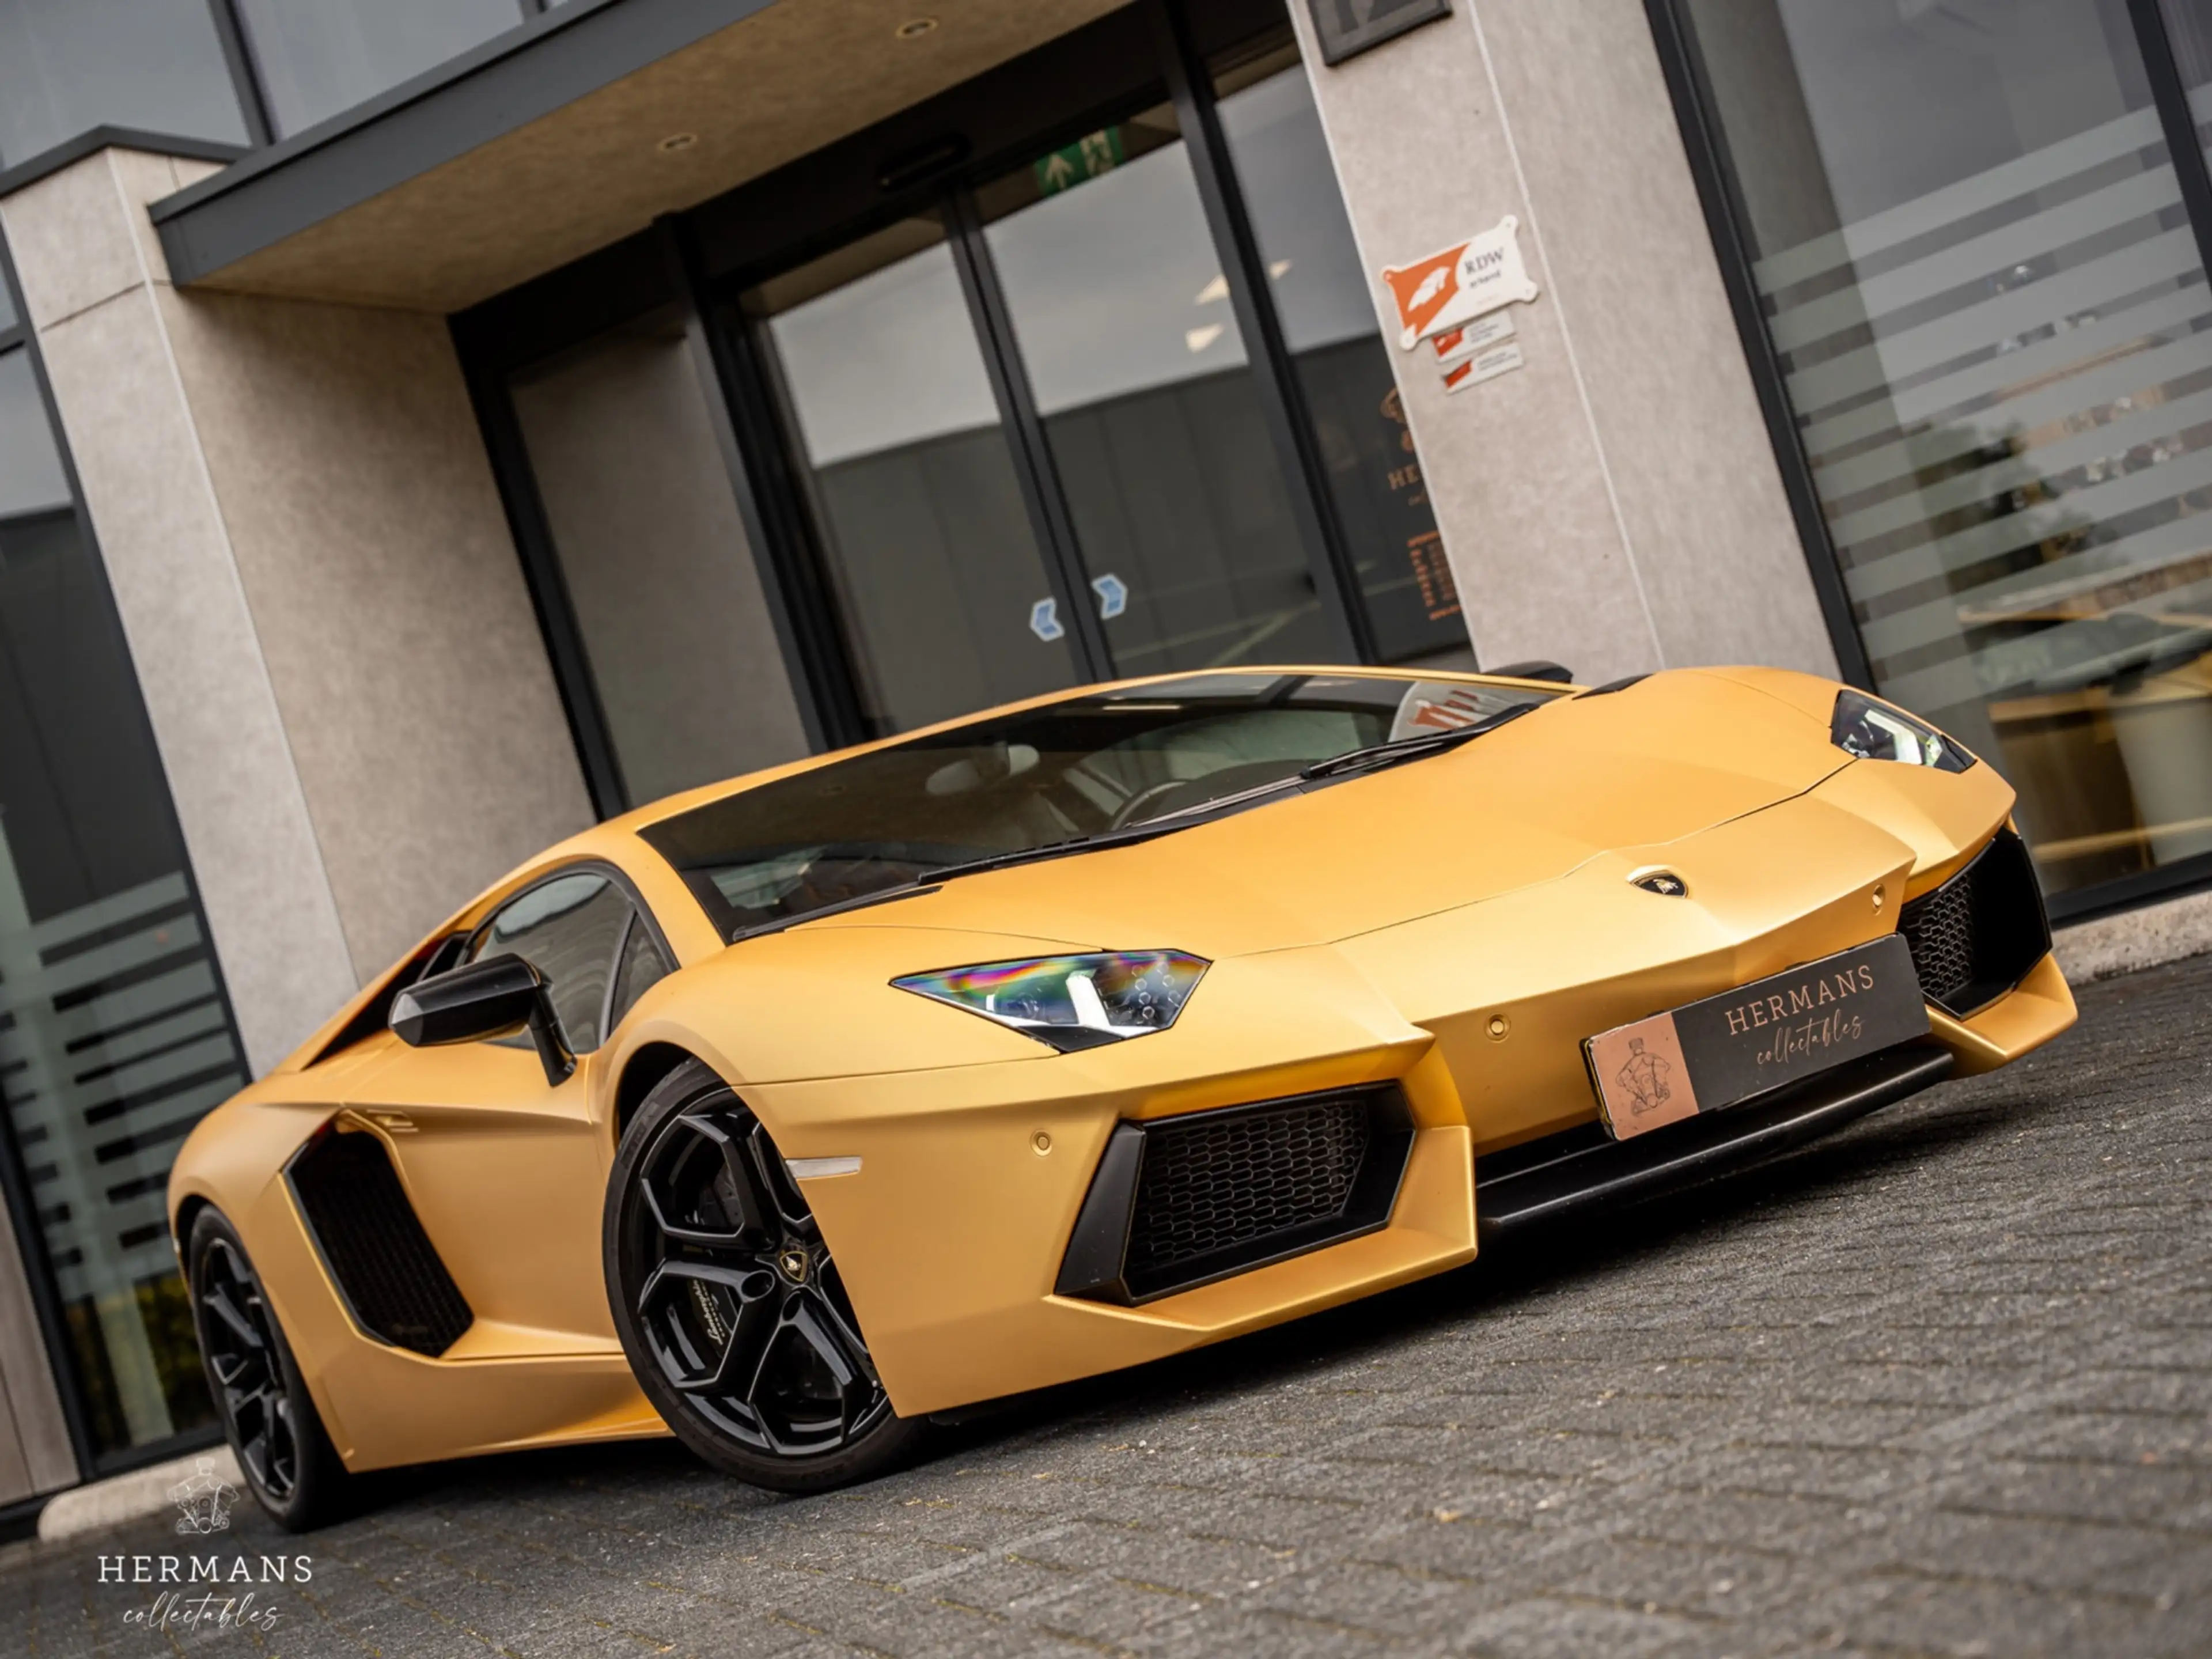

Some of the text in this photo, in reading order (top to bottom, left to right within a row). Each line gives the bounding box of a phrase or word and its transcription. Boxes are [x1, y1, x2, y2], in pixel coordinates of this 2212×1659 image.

[1465, 246, 1504, 275] RDW
[1725, 965, 1873, 1036] HERMANS
[1757, 1008, 1865, 1065] collectables
